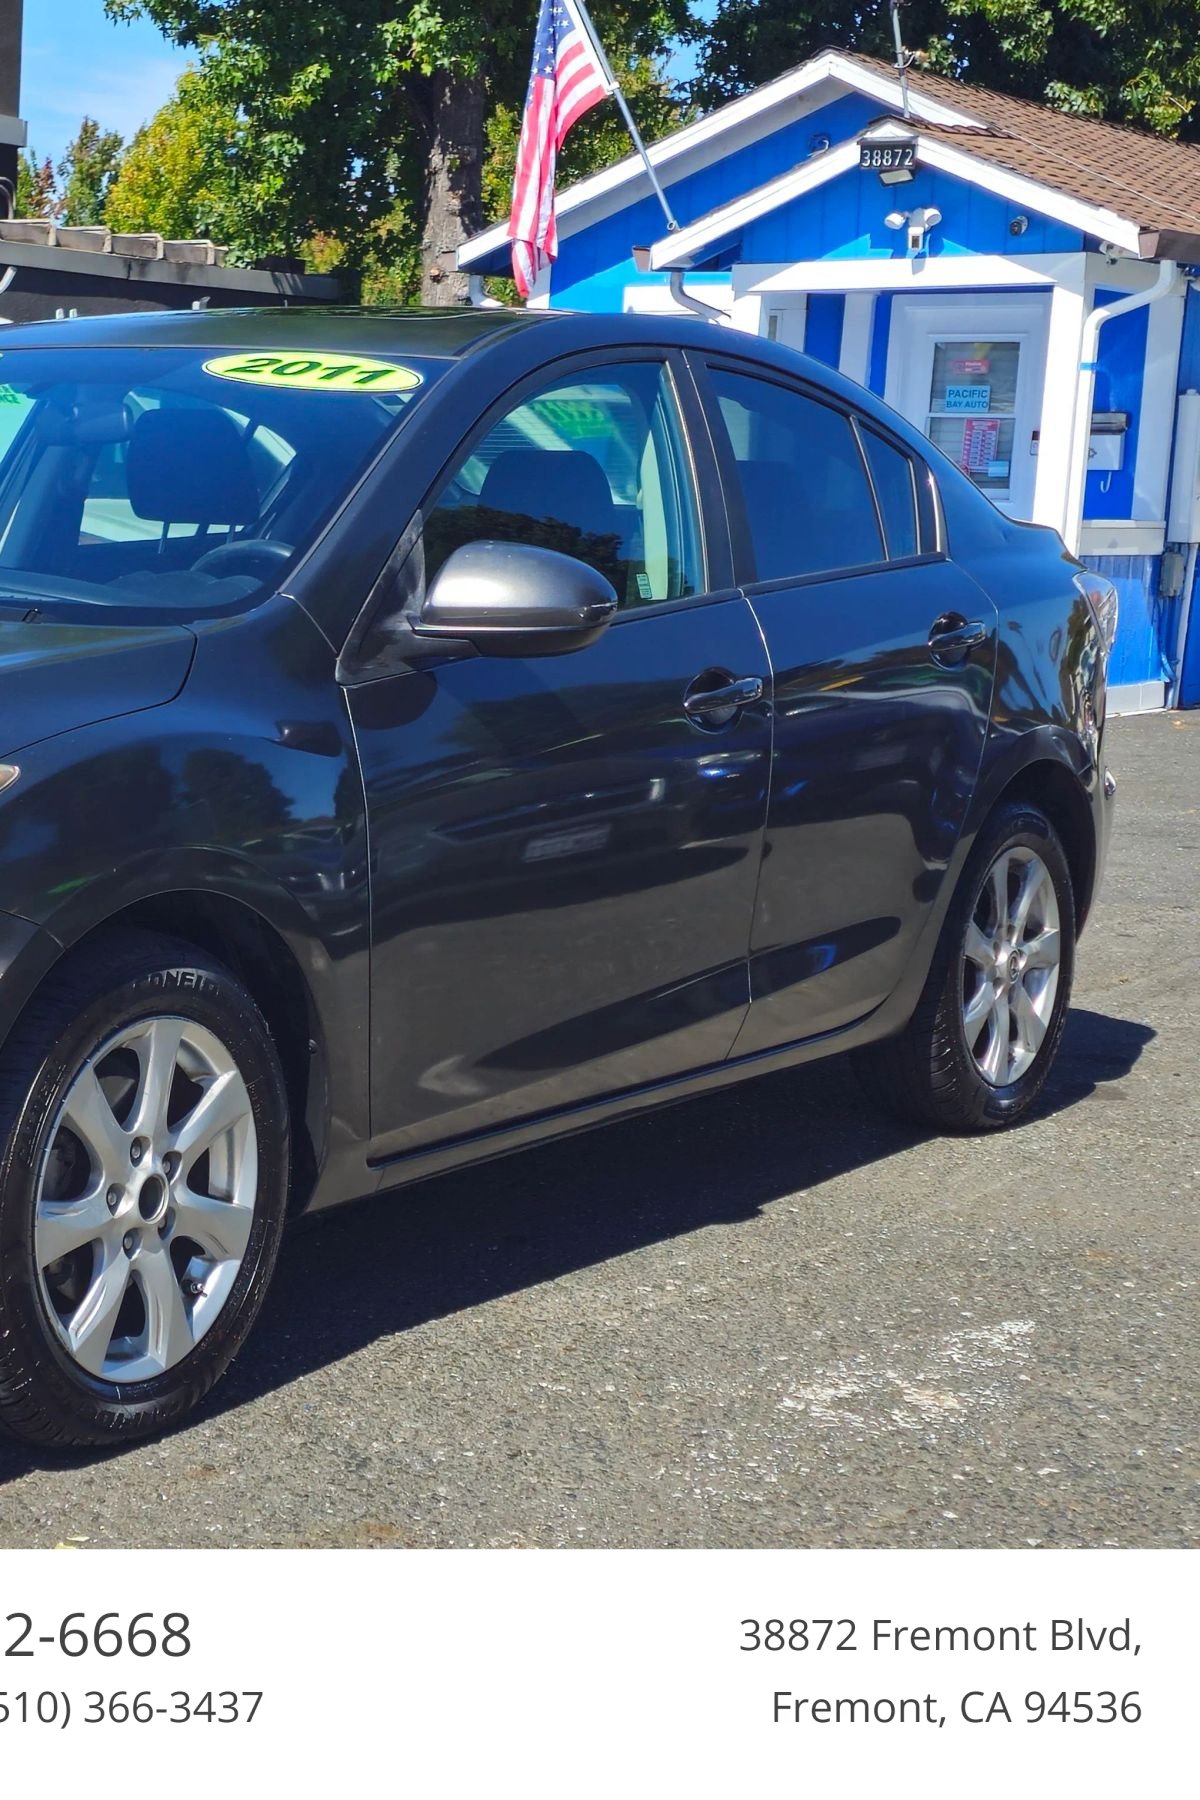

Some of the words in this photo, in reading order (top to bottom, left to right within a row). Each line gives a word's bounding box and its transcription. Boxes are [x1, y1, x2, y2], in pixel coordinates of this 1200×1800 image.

[861, 149, 913, 167] 38872
[224, 358, 396, 384] 2011
[947, 389, 988, 399] PACIFIC
[946, 400, 962, 409] BAY
[964, 400, 989, 409] AUTO
